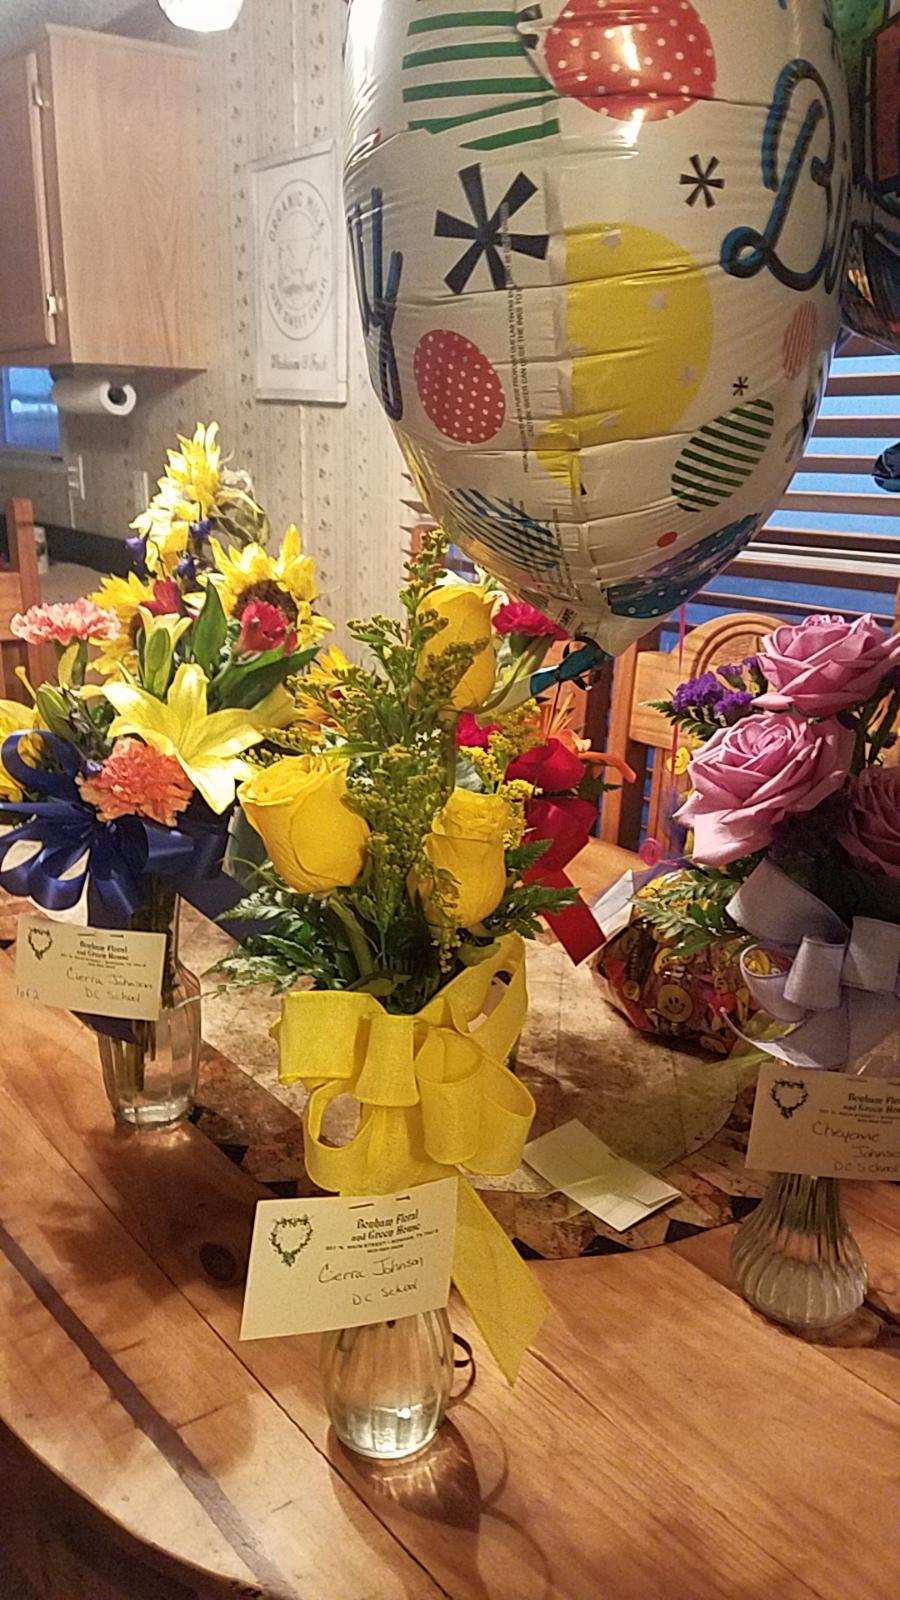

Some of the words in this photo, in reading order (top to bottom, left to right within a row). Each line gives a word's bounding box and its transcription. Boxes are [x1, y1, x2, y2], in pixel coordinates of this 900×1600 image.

[357, 1218, 394, 1229] Bonham
[396, 1208, 419, 1225] Floral
[351, 1232, 366, 1242] and
[368, 1229, 394, 1241] Green
[396, 1223, 421, 1236] House
[372, 1255, 424, 1276] Johnson
[352, 1292, 374, 1306] DC
[380, 1278, 418, 1298] School
